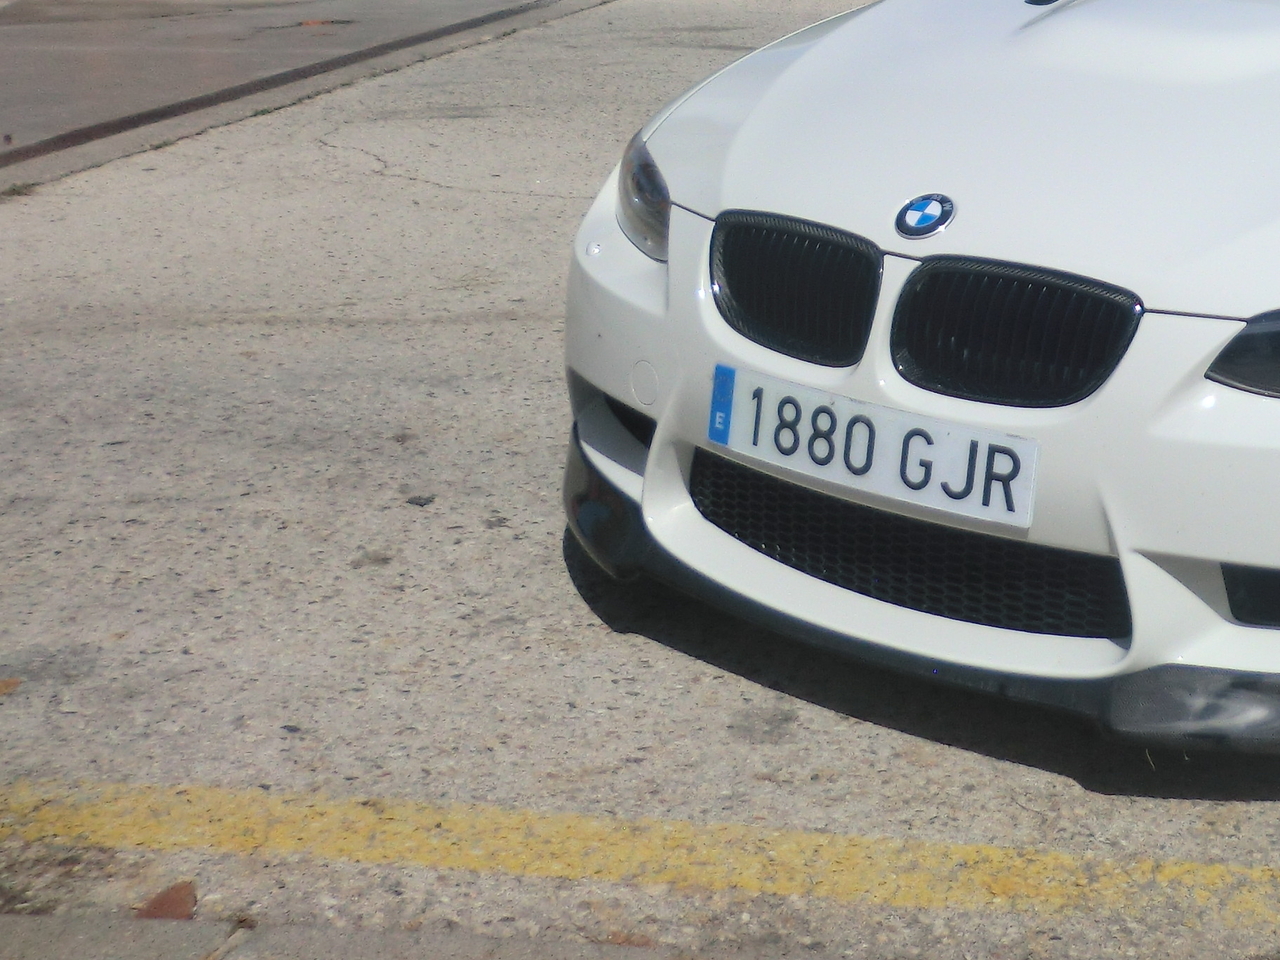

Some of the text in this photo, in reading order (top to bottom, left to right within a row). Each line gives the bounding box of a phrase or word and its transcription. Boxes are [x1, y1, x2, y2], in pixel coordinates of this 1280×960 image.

[715, 411, 726, 430] E
[751, 386, 1022, 513] 1880 GJR
